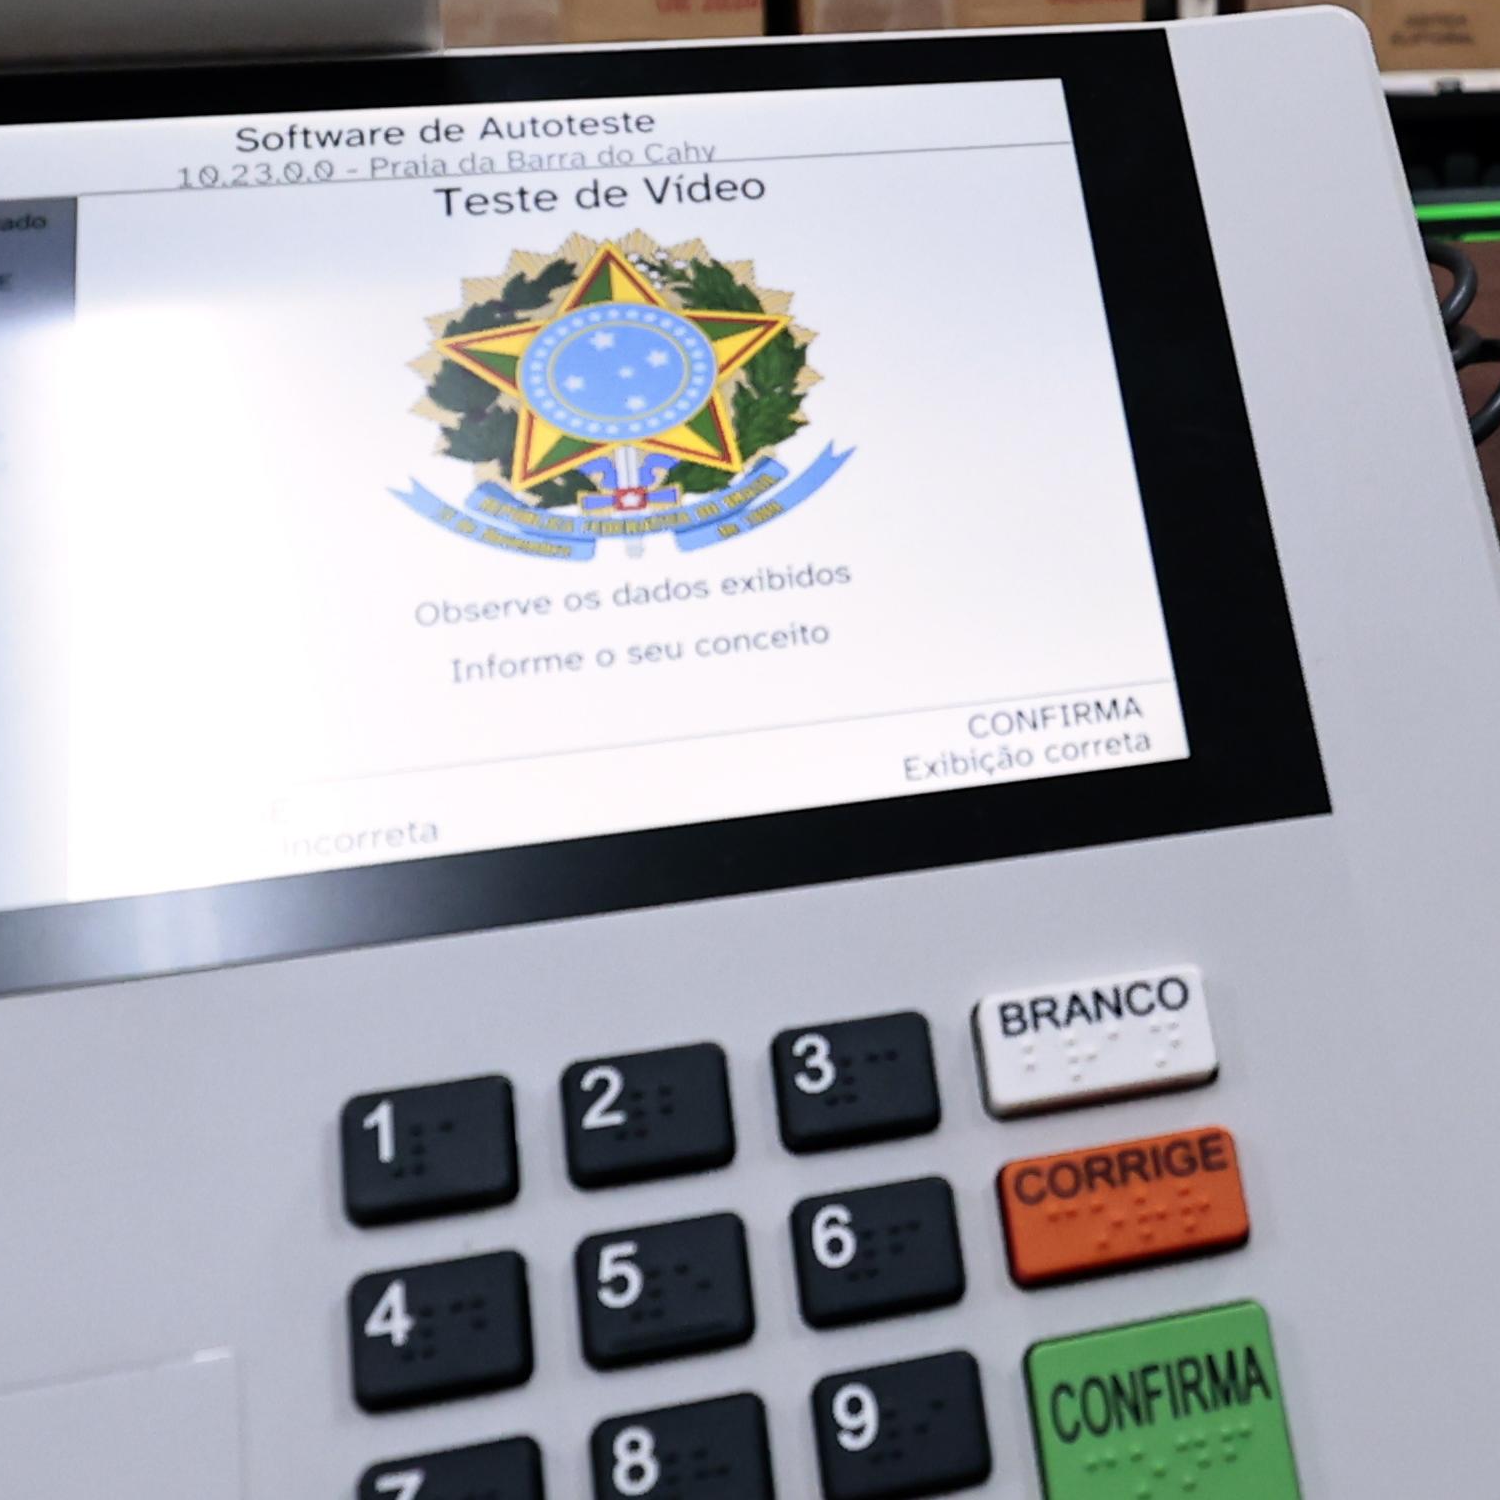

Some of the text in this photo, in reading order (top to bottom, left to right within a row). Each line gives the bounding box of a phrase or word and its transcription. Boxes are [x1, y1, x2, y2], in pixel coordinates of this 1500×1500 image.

[237, 113, 655, 152] Software de Autoteste
[179, 141, 717, 189] 10.23.0.0 Praia da Barra do Cahy
[434, 173, 765, 216] Teste de Vídeo
[415, 564, 851, 626] Observe os dados exibidos
[452, 623, 829, 683] Informe o seu conceito
[968, 696, 1143, 739] CONFIRMA
[904, 733, 1151, 780] Exibição correta
[999, 977, 1190, 1038] BRANCO
[793, 1035, 835, 1093] 3
[581, 1066, 625, 1129] 2
[364, 1102, 393, 1162] 1
[1013, 1135, 1230, 1206] CORRIGE
[813, 1205, 856, 1267] 6
[599, 1242, 642, 1308] 5
[365, 1282, 413, 1345] 4
[833, 1384, 878, 1450] 9
[1050, 1346, 1272, 1445] CONFIRMA
[613, 1427, 658, 1495] 8
